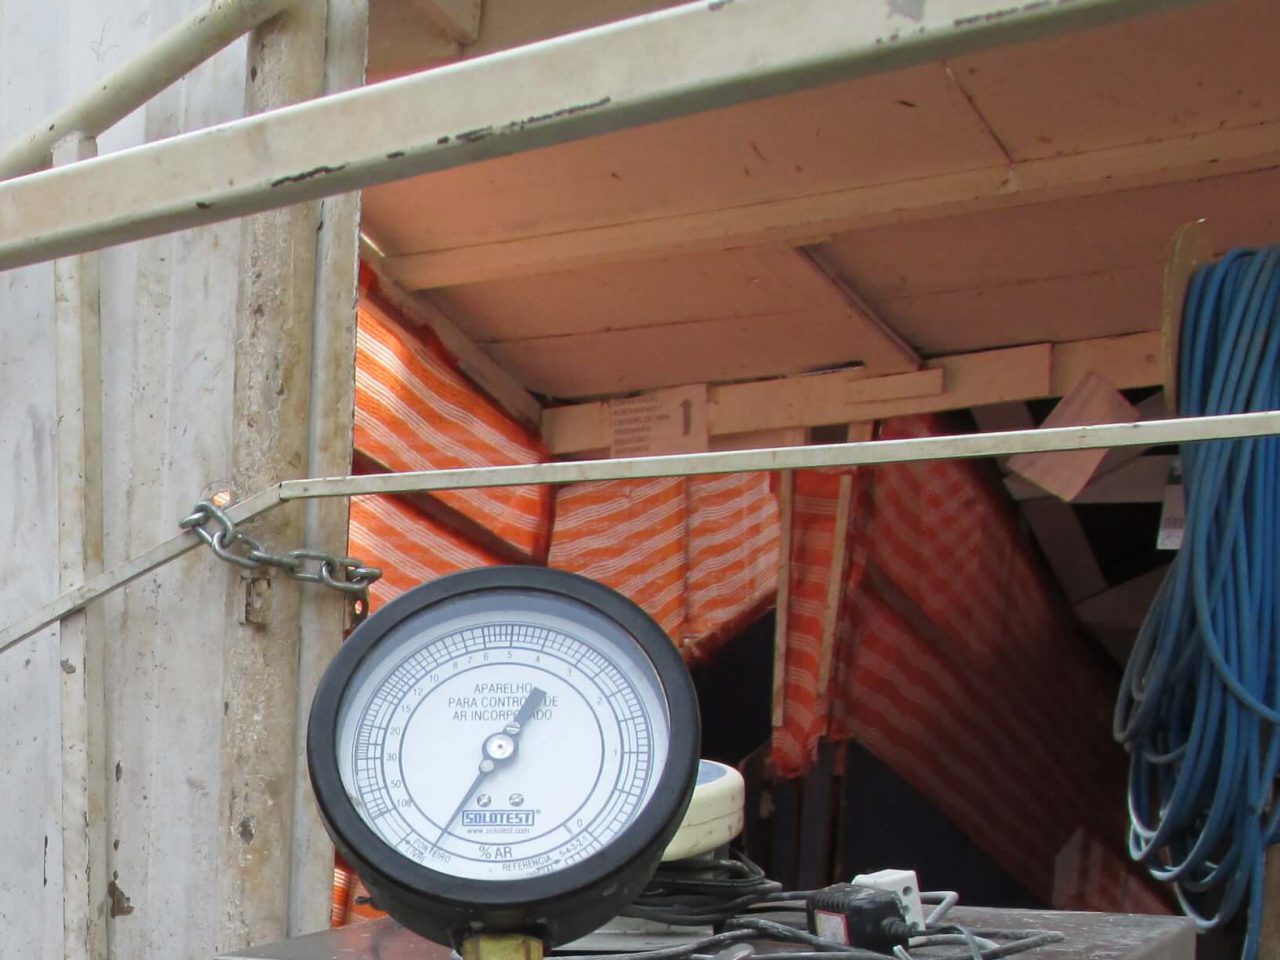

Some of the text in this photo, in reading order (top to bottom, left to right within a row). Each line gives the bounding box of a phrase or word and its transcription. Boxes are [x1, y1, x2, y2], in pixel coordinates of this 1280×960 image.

[483, 652, 489, 661] 6
[507, 651, 513, 659] 5
[535, 655, 541, 663] 4
[429, 674, 439, 682] 10
[413, 688, 423, 696] 12
[473, 682, 533, 695] APARELHO
[448, 695, 559, 708] PARA CONTRO DE
[401, 704, 412, 713] 15
[452, 709, 468, 721] AR
[390, 727, 401, 736] 20
[386, 752, 398, 761] 30
[390, 780, 402, 788] 50
[465, 812, 532, 824] SOLOTEST
[494, 846, 513, 860] AR
